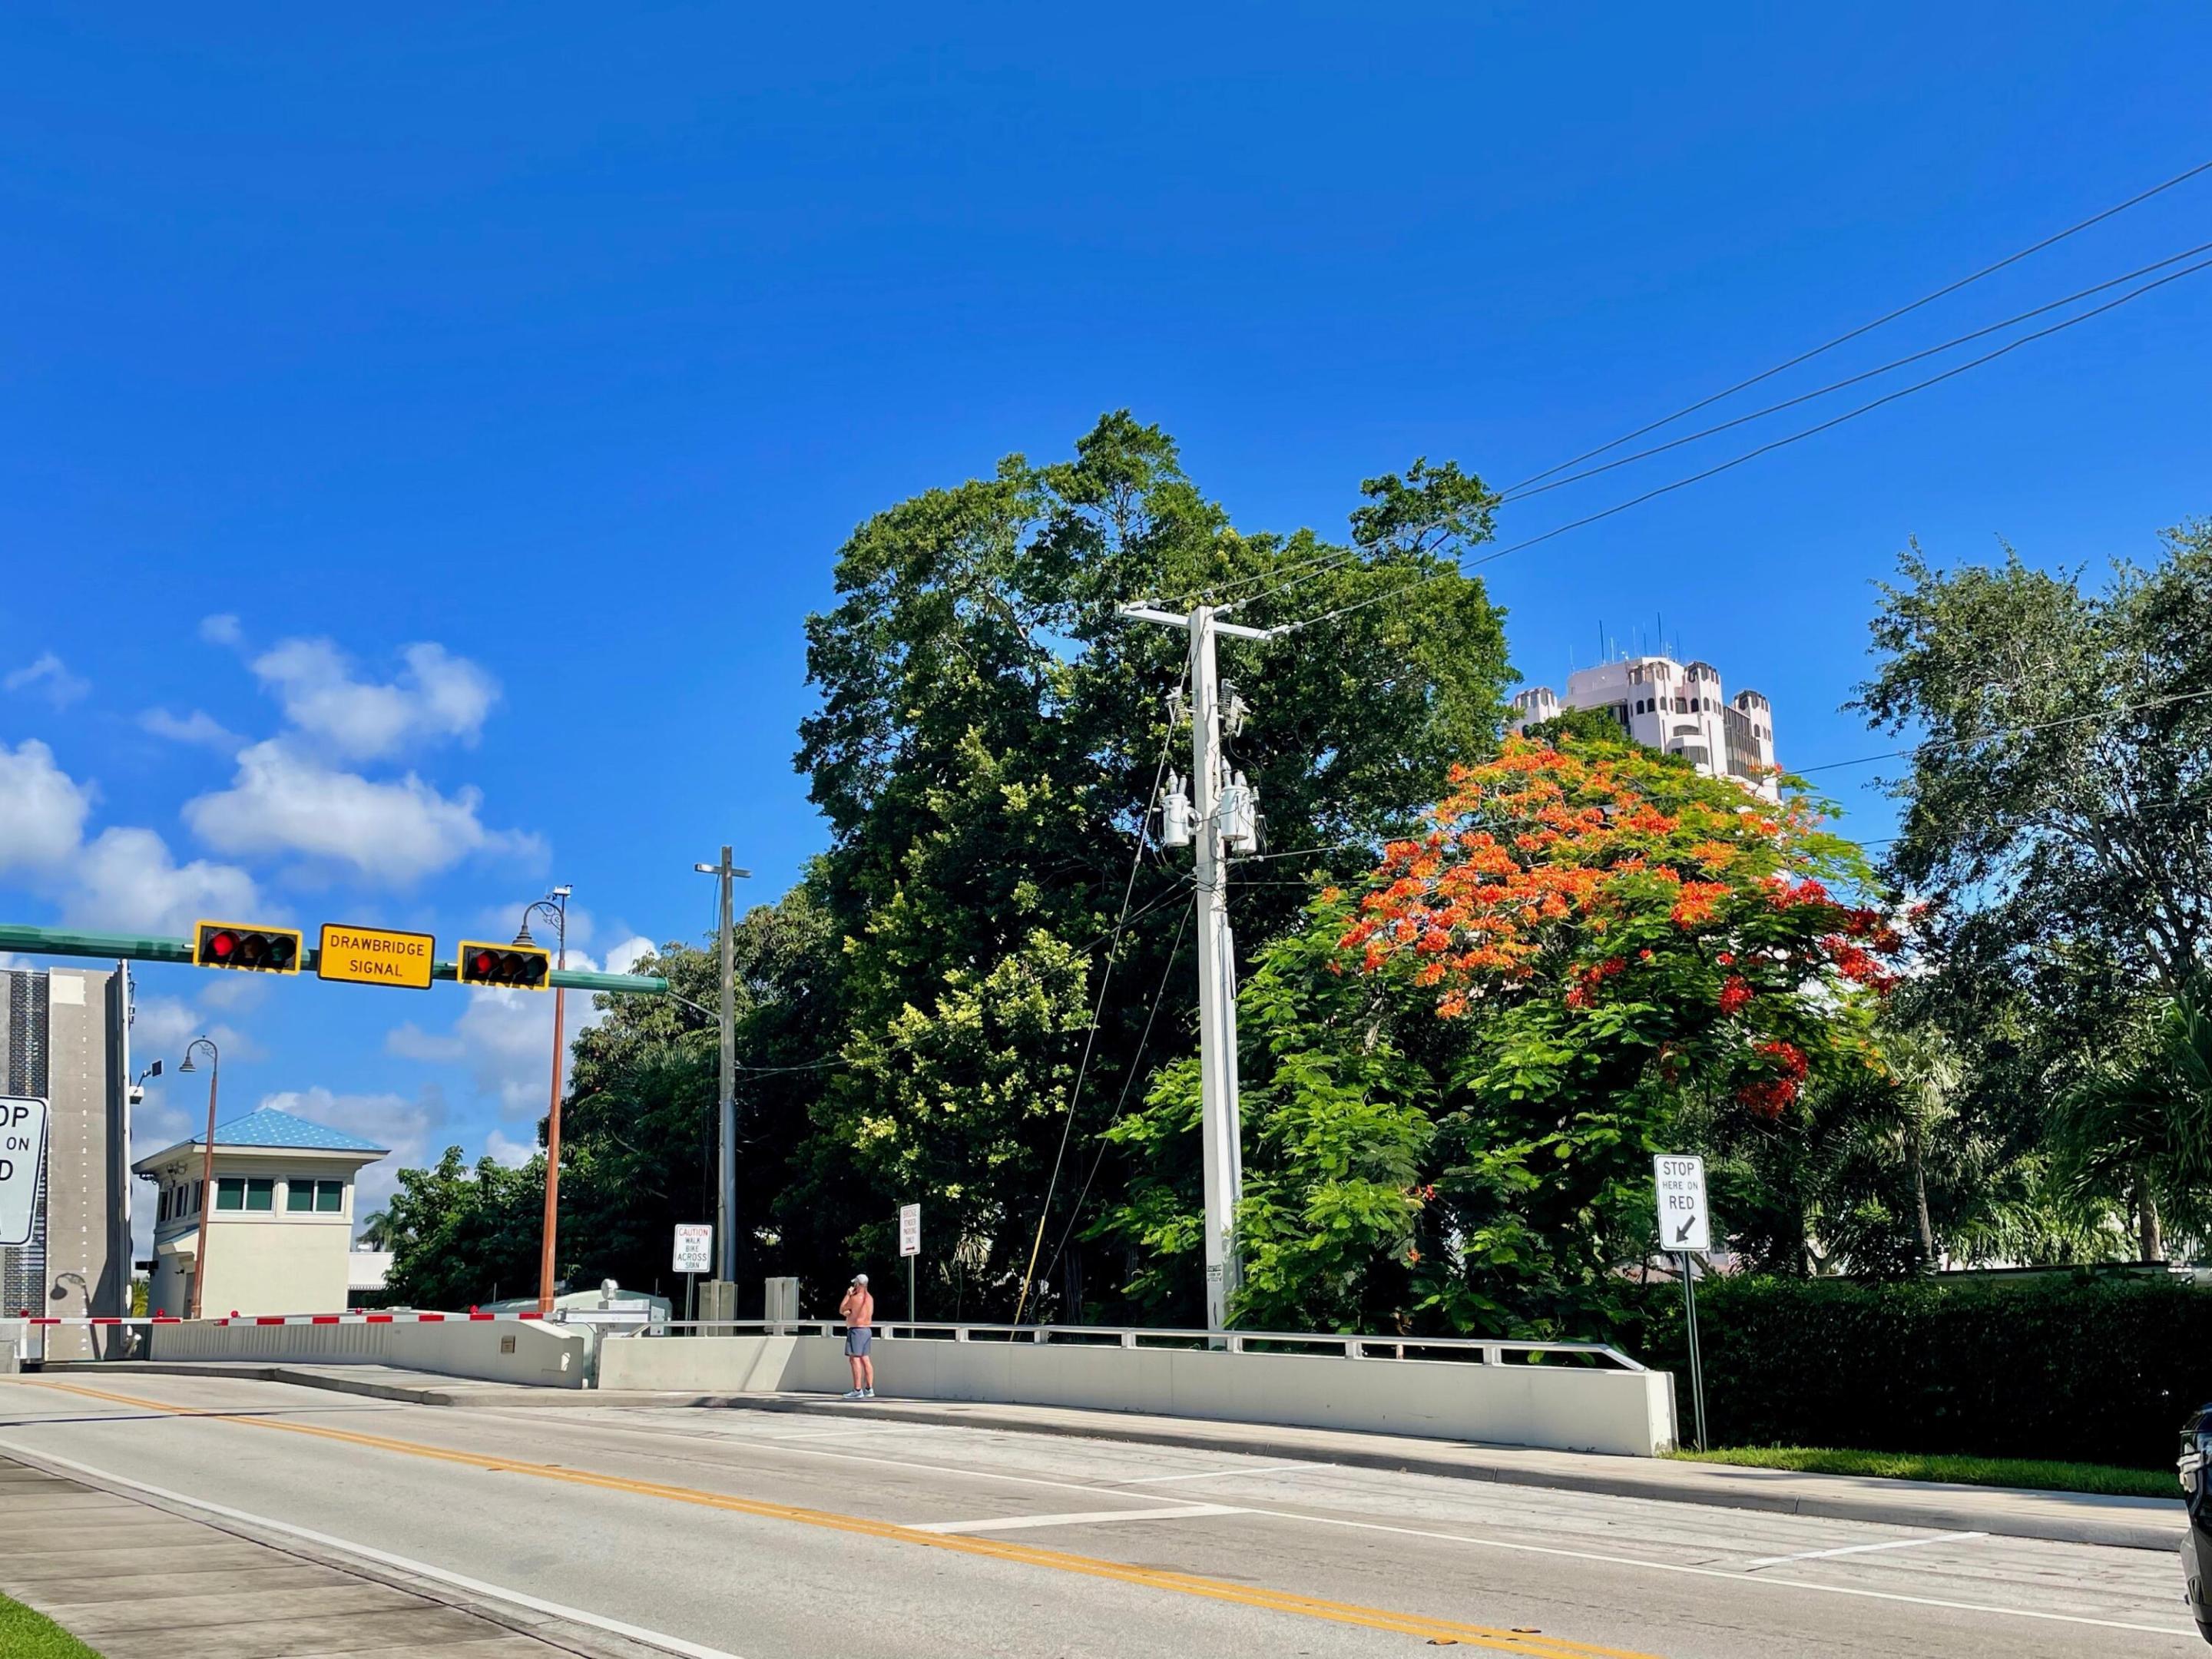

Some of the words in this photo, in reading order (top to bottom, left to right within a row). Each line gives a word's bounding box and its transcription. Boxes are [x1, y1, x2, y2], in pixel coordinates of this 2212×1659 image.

[330, 935, 425, 956] DRAWBRIDGE
[349, 959, 402, 977] SIGNAL
[0, 1104, 29, 1128] OP
[6, 1137, 29, 1151] ON
[1663, 1161, 1694, 1176] STOP
[1662, 1181, 1683, 1190] HERE
[1687, 1181, 1699, 1191] ON
[1669, 1195, 1694, 1210] RED
[678, 1228, 708, 1237] CAUTION
[677, 1253, 707, 1261] ACROSS
